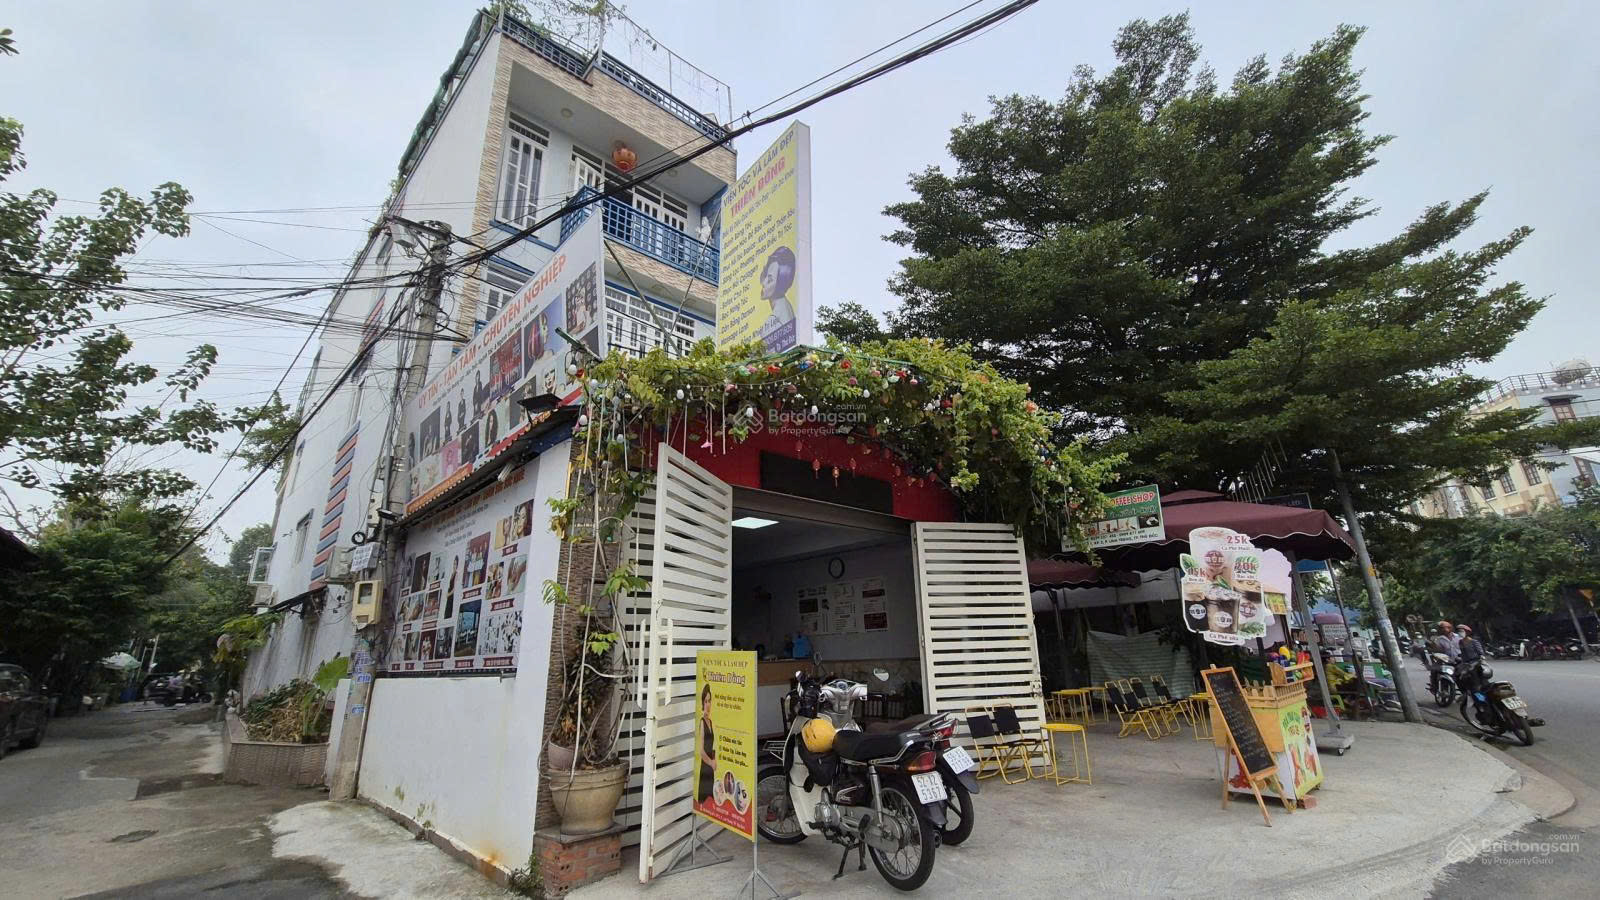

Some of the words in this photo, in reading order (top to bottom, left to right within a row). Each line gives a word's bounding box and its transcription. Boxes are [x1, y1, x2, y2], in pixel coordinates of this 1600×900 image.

[738, 173, 751, 192] TÓC
[752, 160, 762, 177] VÀ
[764, 146, 778, 167] LÀM
[731, 185, 756, 217] THIÊN
[482, 302, 521, 348] CHUYÊN
[524, 254, 567, 305] NGHIỆP
[1111, 496, 1132, 506] OFFEE
[1132, 491, 1155, 504] SHOP
[1226, 535, 1248, 544] 25k
[922, 787, 941, 801] 5367
